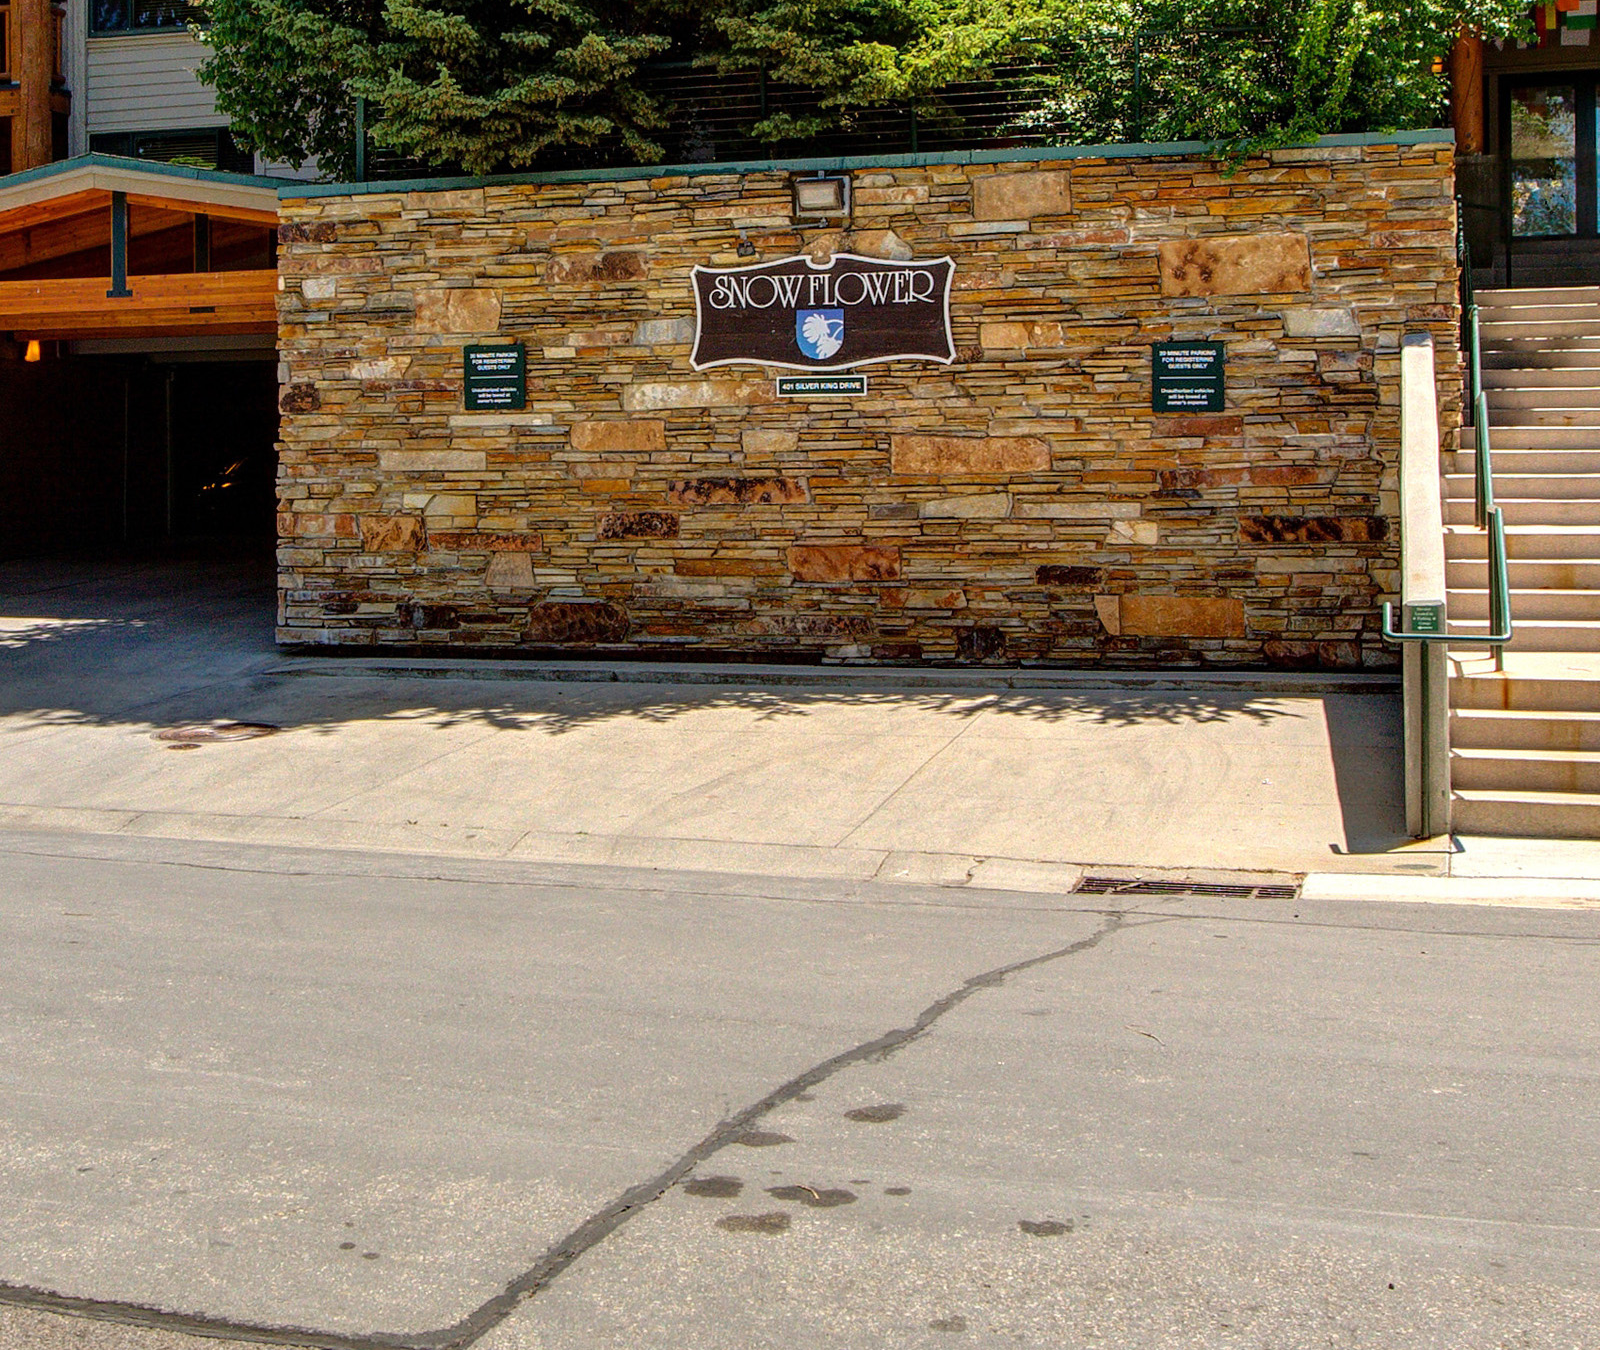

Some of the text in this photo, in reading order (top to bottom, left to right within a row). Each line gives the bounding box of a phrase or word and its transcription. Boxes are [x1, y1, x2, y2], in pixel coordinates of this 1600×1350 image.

[795, 382, 820, 390] SILVER
[820, 382, 838, 390] KING
[839, 381, 861, 389] DRIVE
